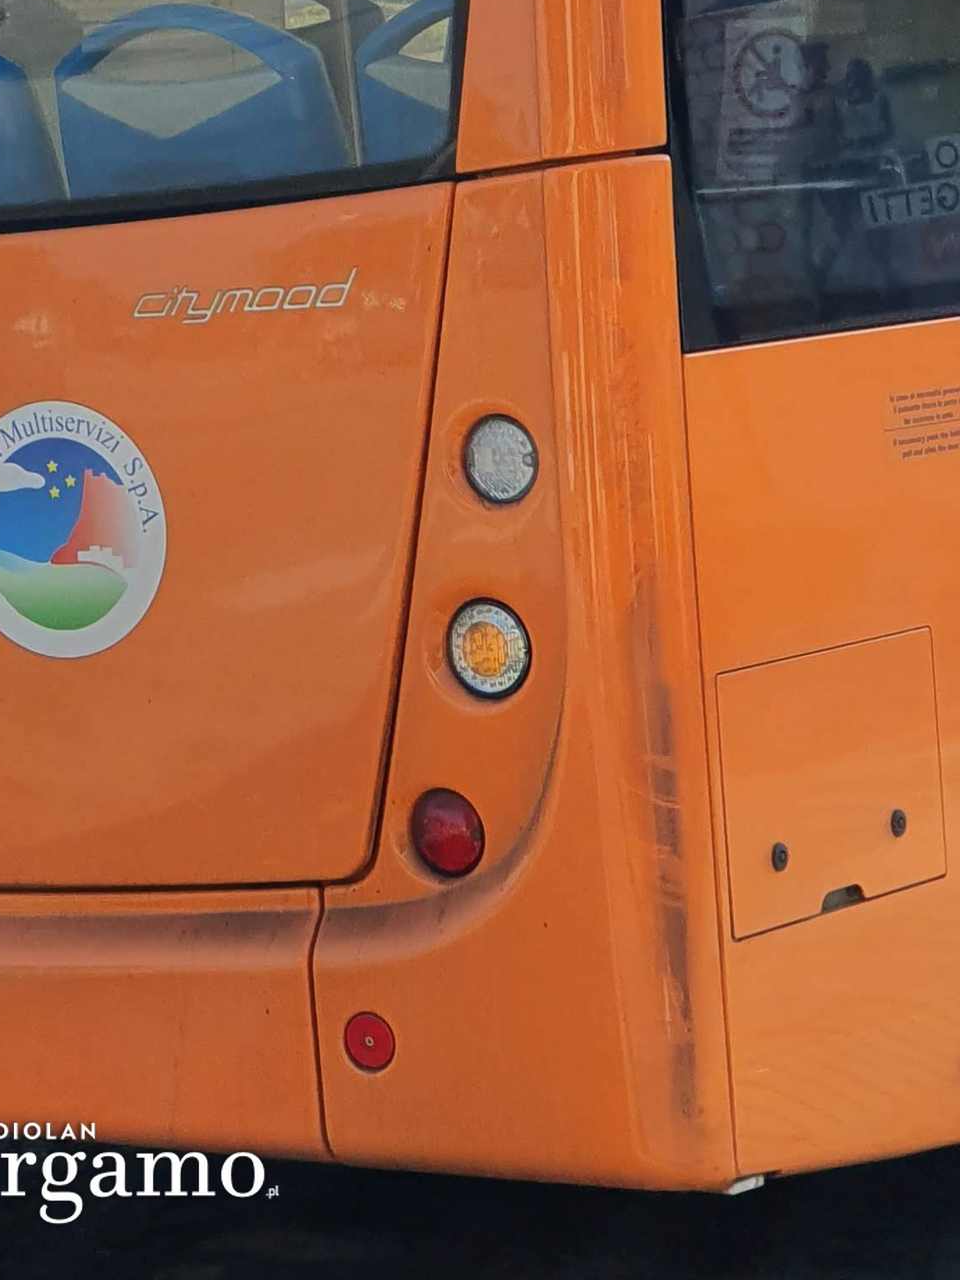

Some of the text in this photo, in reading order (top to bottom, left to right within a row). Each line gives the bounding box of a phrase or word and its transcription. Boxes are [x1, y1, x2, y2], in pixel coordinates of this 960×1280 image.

[133, 267, 358, 324] citymood
[0, 409, 126, 454] Multiservizi
[122, 455, 160, 534] S.p.A.
